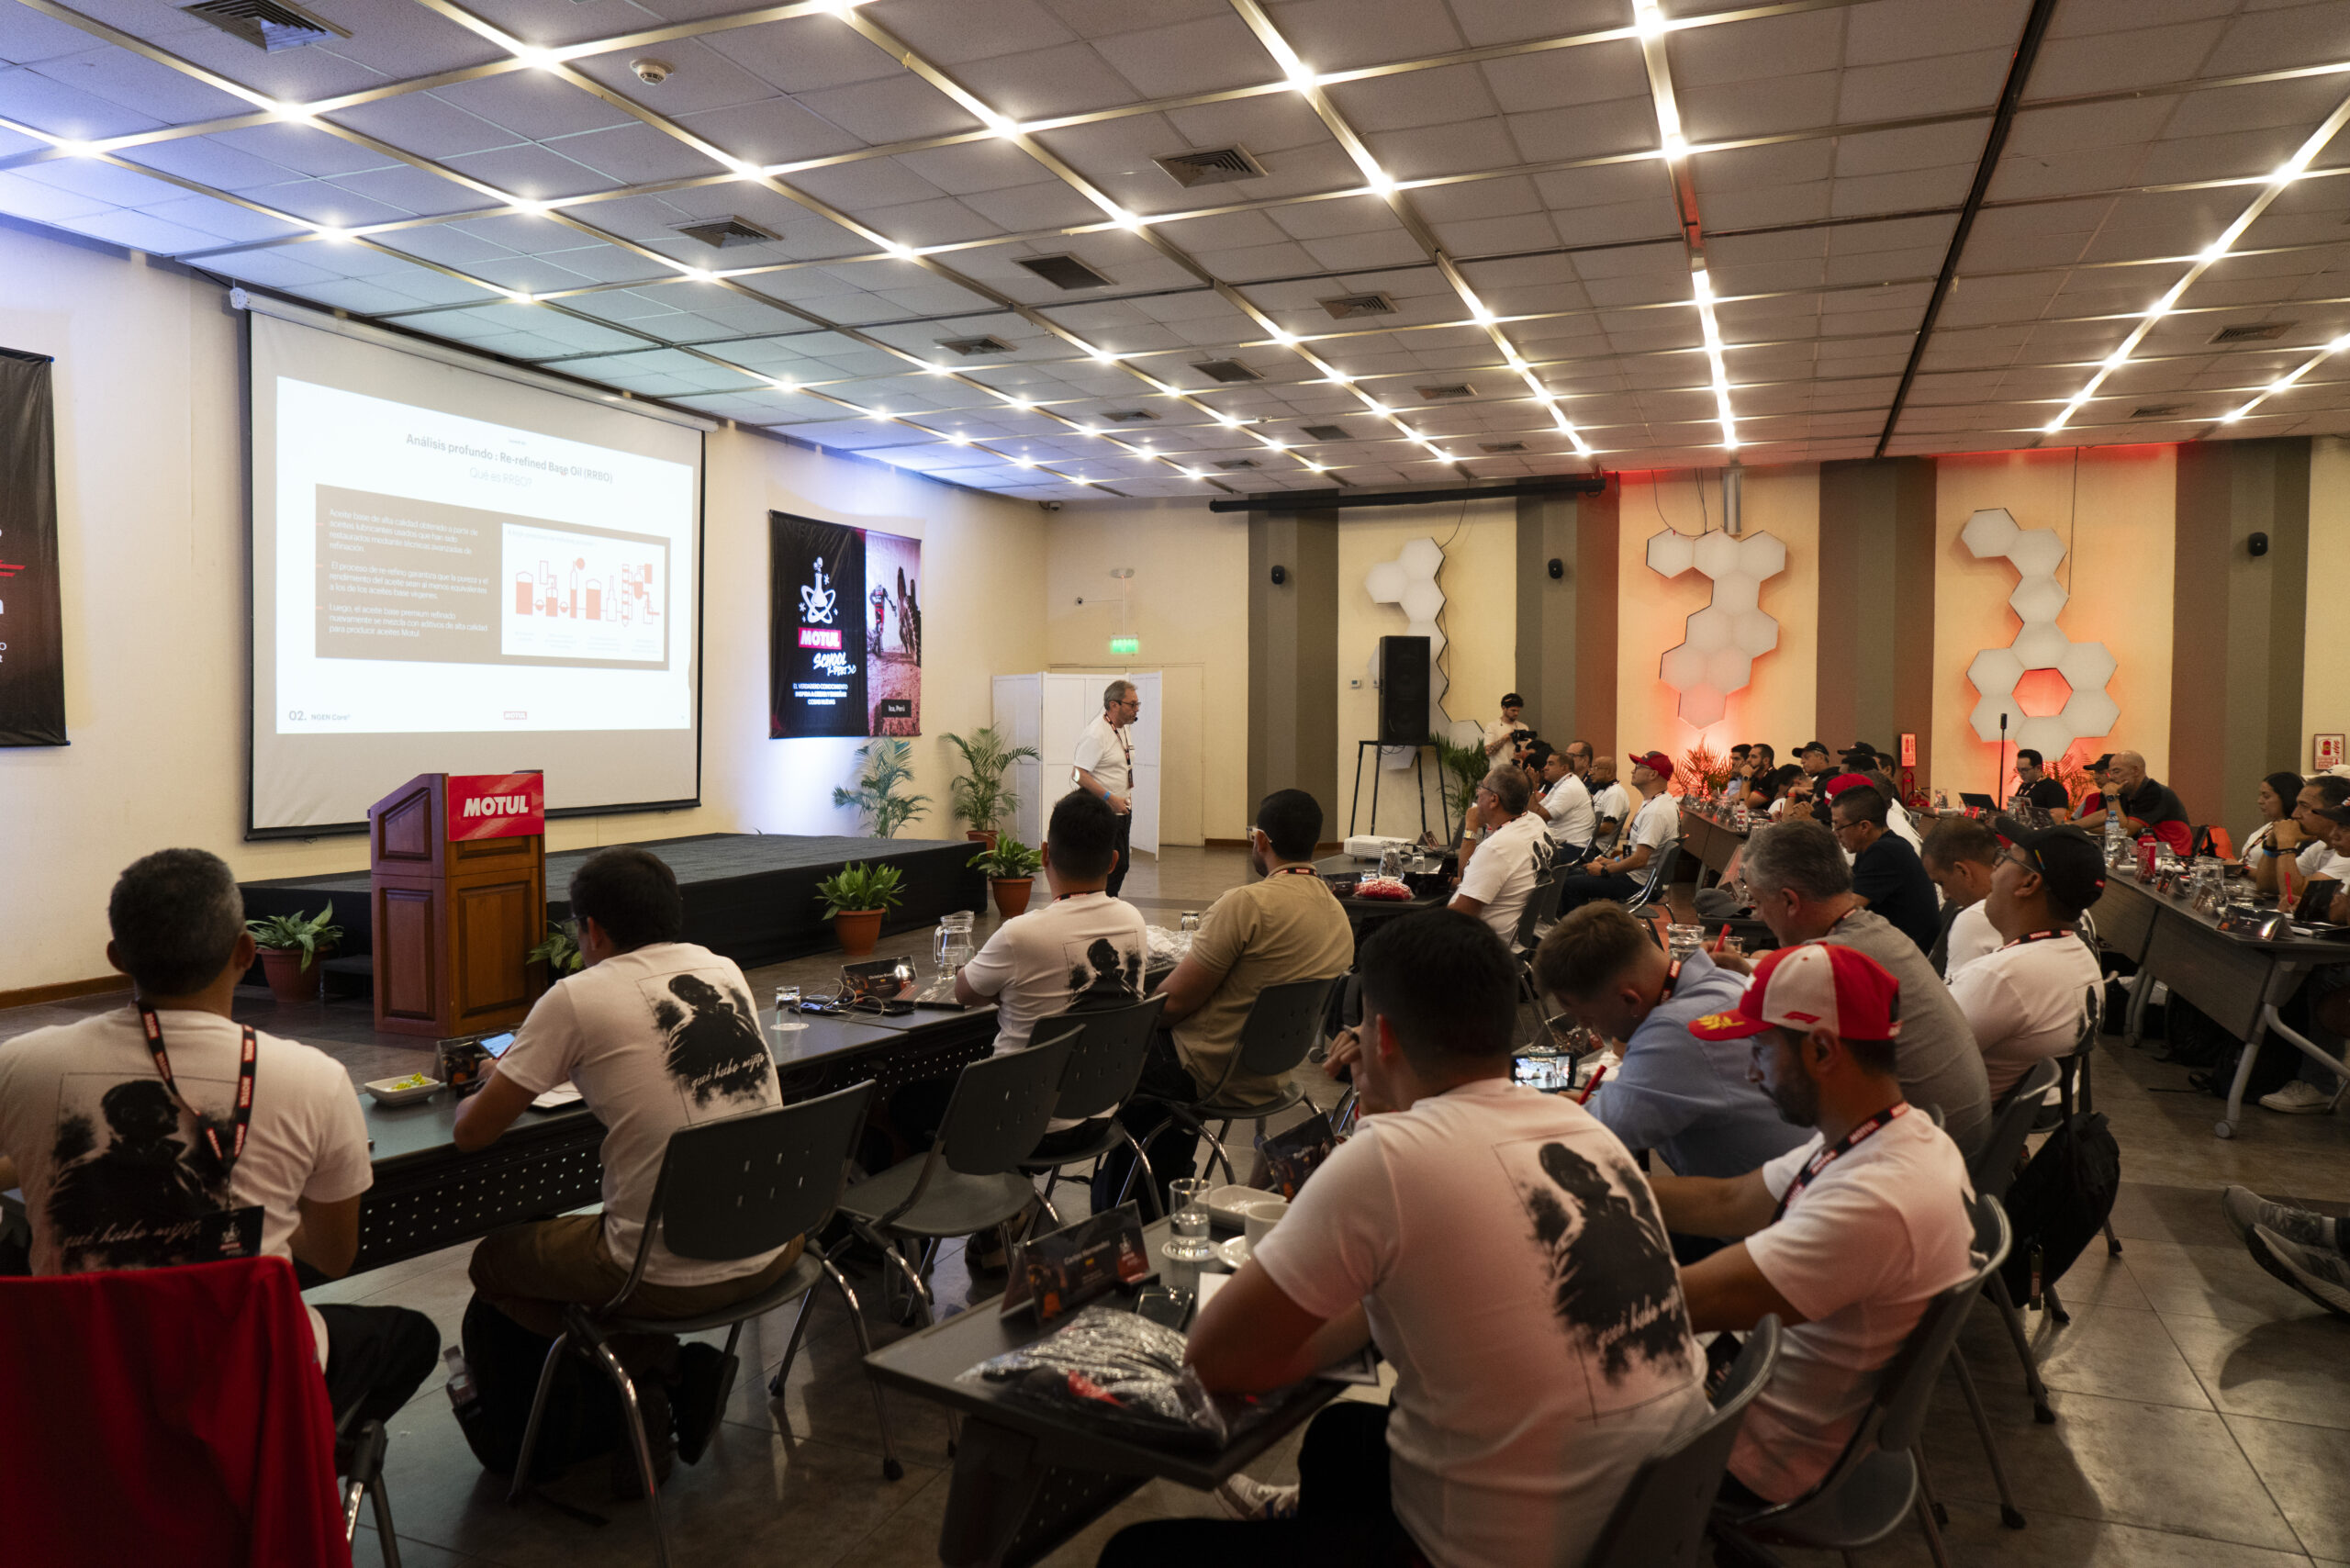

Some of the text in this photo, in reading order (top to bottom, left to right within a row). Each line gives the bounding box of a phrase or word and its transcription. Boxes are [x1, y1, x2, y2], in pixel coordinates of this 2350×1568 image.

[405, 433, 446, 451] Análisis
[448, 443, 493, 460] profundo
[499, 452, 547, 470] Re-refined
[548, 461, 569, 476] Base
[570, 465, 583, 477] Oil
[584, 468, 613, 485] (RRBO)
[490, 473, 501, 484] es
[502, 473, 532, 487] RRBO?
[800, 629, 841, 647] MOTUL
[812, 651, 847, 670] SCHOOL
[288, 710, 308, 722] 02.
[463, 795, 530, 818] MOTUL
[714, 1058, 740, 1080] hubo
[239, 1075, 252, 1108] MOTUL
[1849, 1110, 1880, 1145] MOTUL
